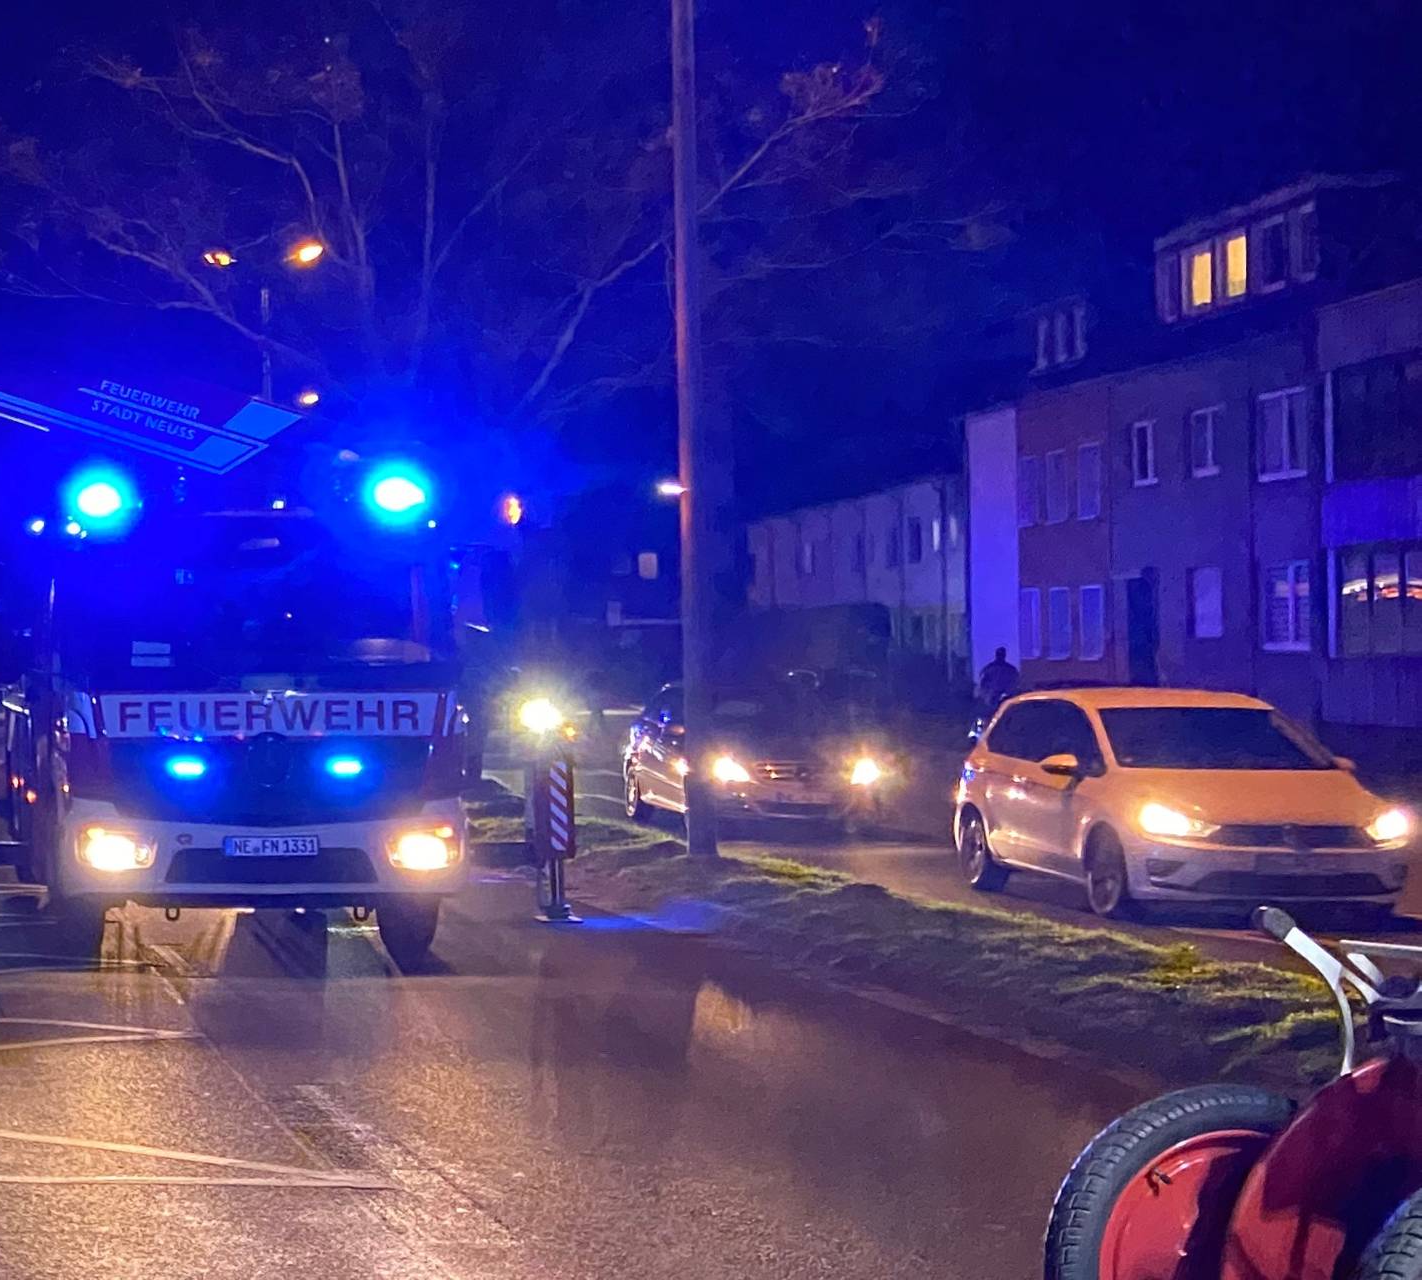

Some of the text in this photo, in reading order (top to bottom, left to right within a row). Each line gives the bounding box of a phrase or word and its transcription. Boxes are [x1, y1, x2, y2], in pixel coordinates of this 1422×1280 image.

[100, 379, 200, 419] FEUERWEHR
[91, 399, 197, 440] STADT NEUSS
[118, 700, 420, 732] FEUERWEHR
[234, 839, 252, 854] NE
[283, 838, 316, 853] 1331
